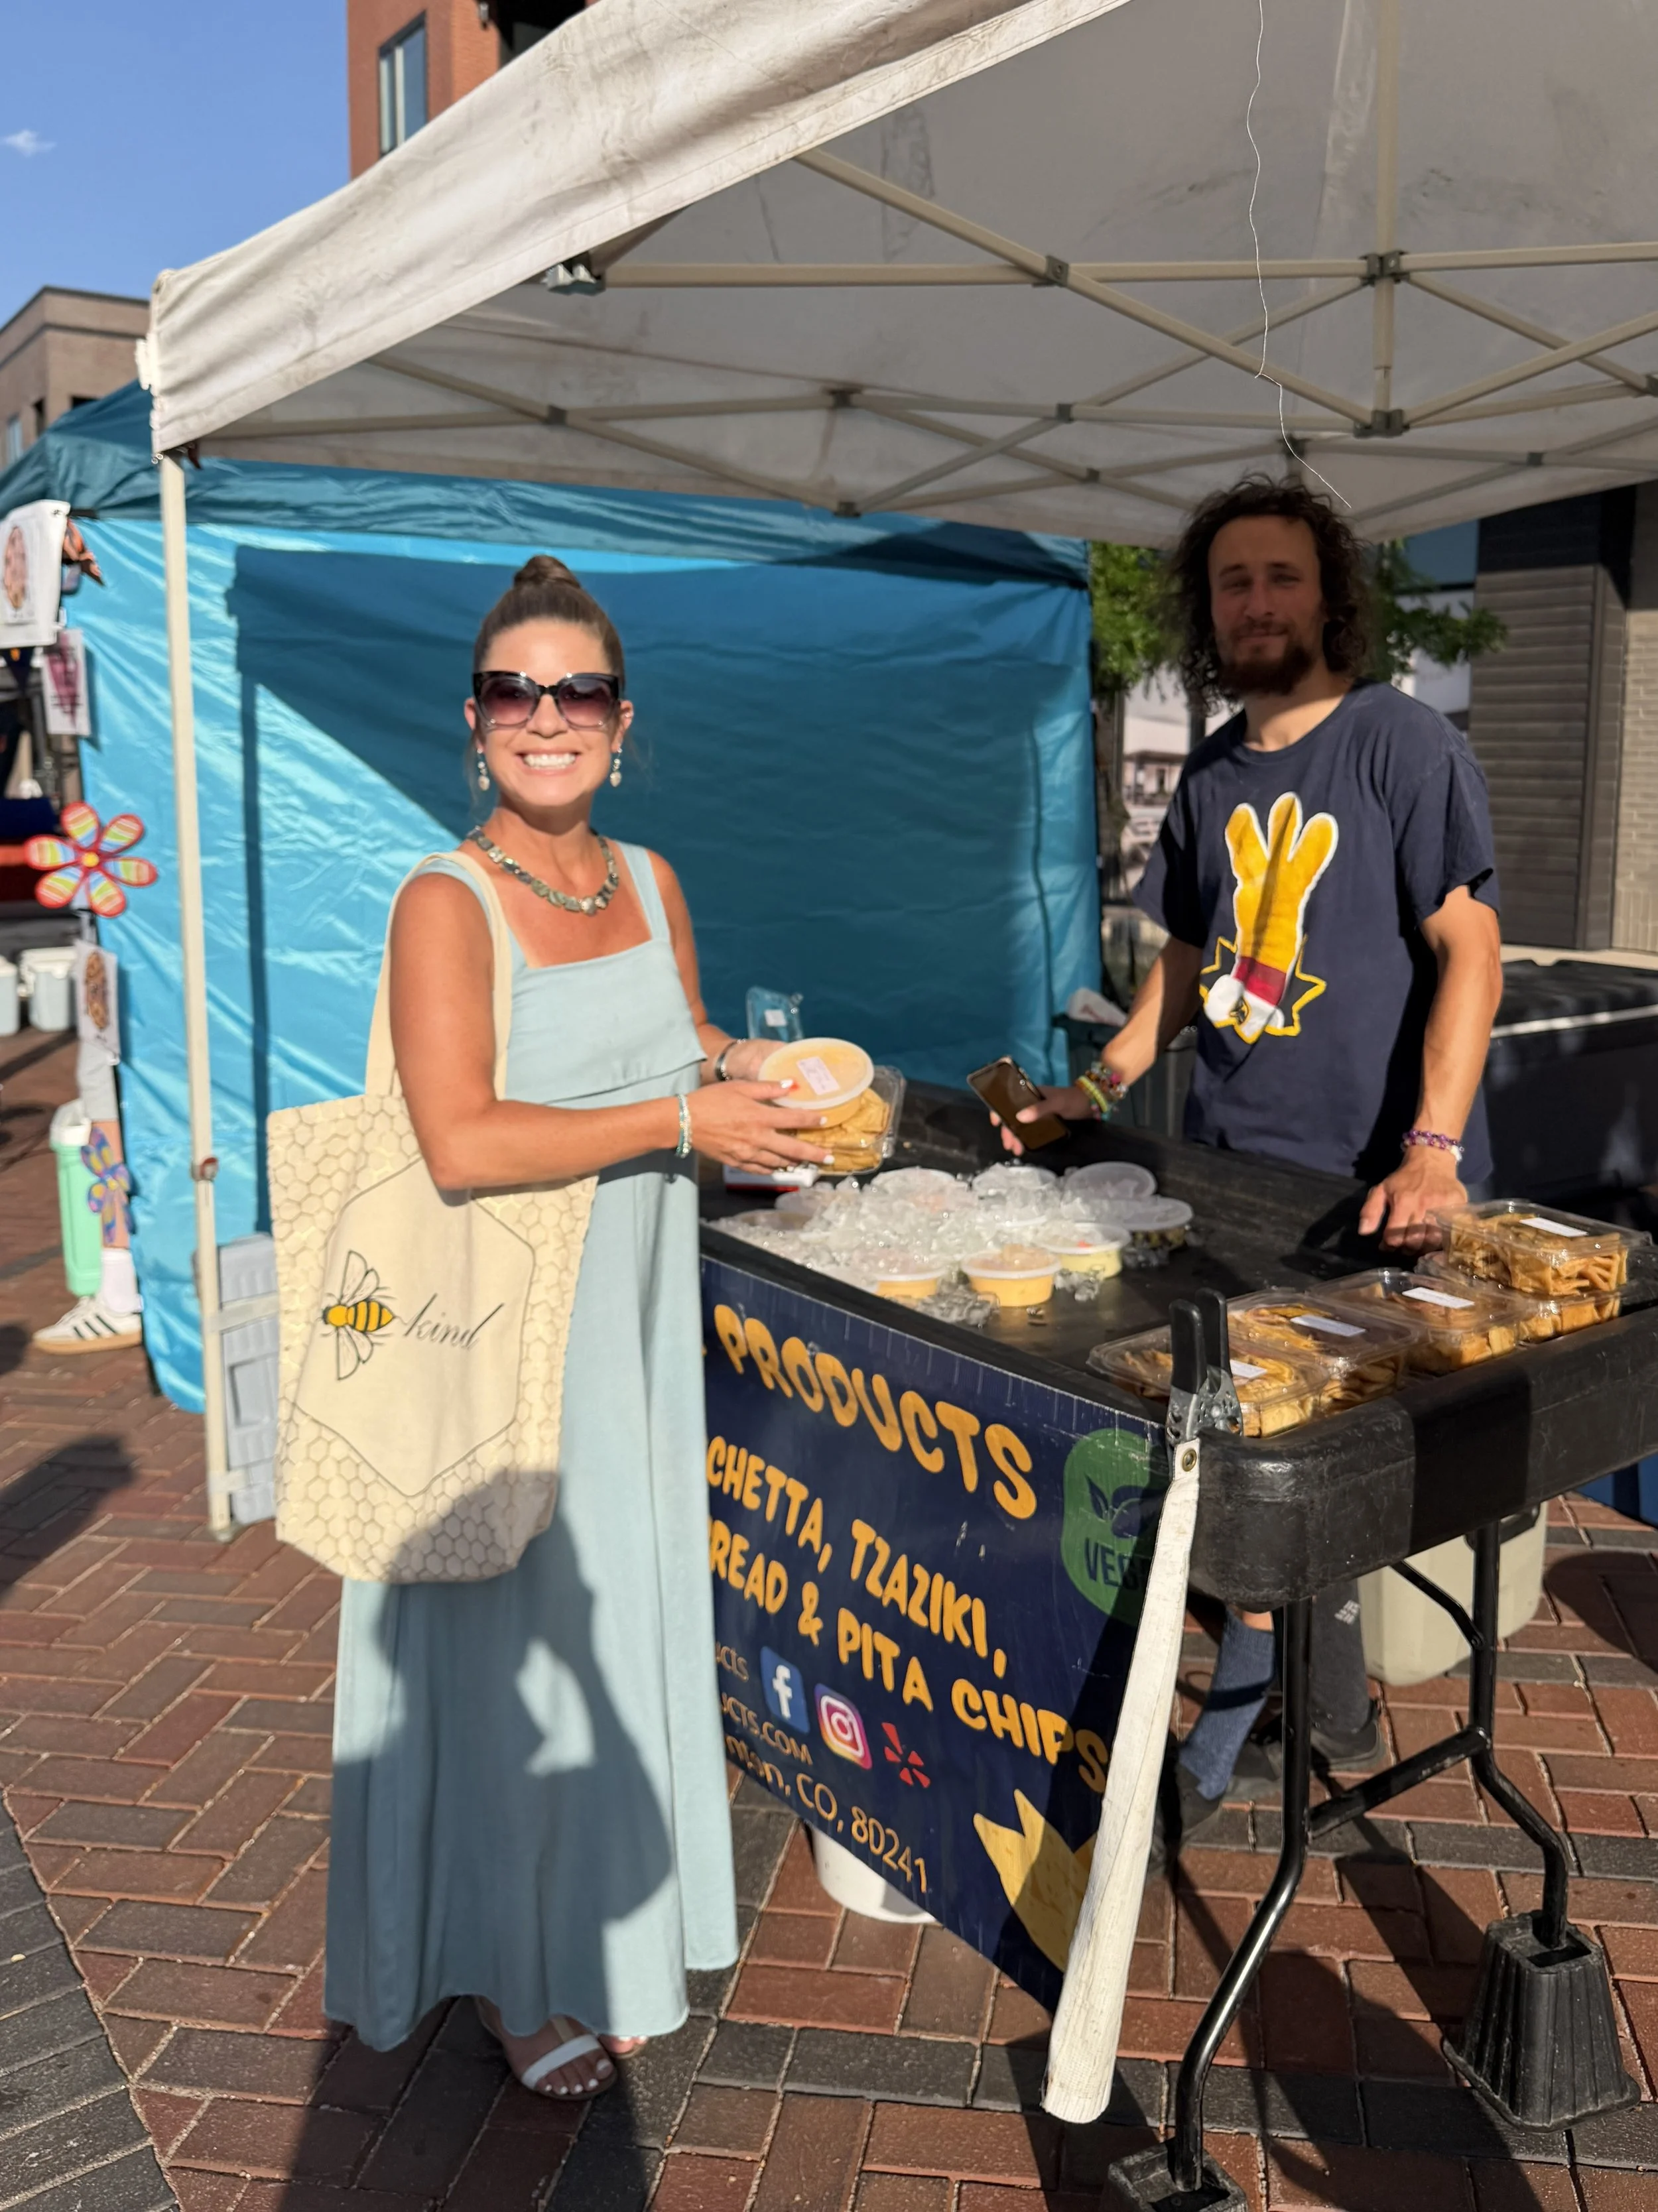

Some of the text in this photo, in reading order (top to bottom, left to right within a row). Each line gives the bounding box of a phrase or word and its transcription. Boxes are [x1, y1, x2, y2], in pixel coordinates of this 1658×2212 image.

[403, 1292, 505, 1351] kind
[714, 1304, 1037, 1520] PRODUCTS
[706, 1435, 1007, 1679] CHETTA, TZAZIKI,
[708, 1515, 1110, 1794] READ & PITA CHIPS
[797, 1773, 844, 1833] CO,
[852, 1806, 927, 1894] 80241
